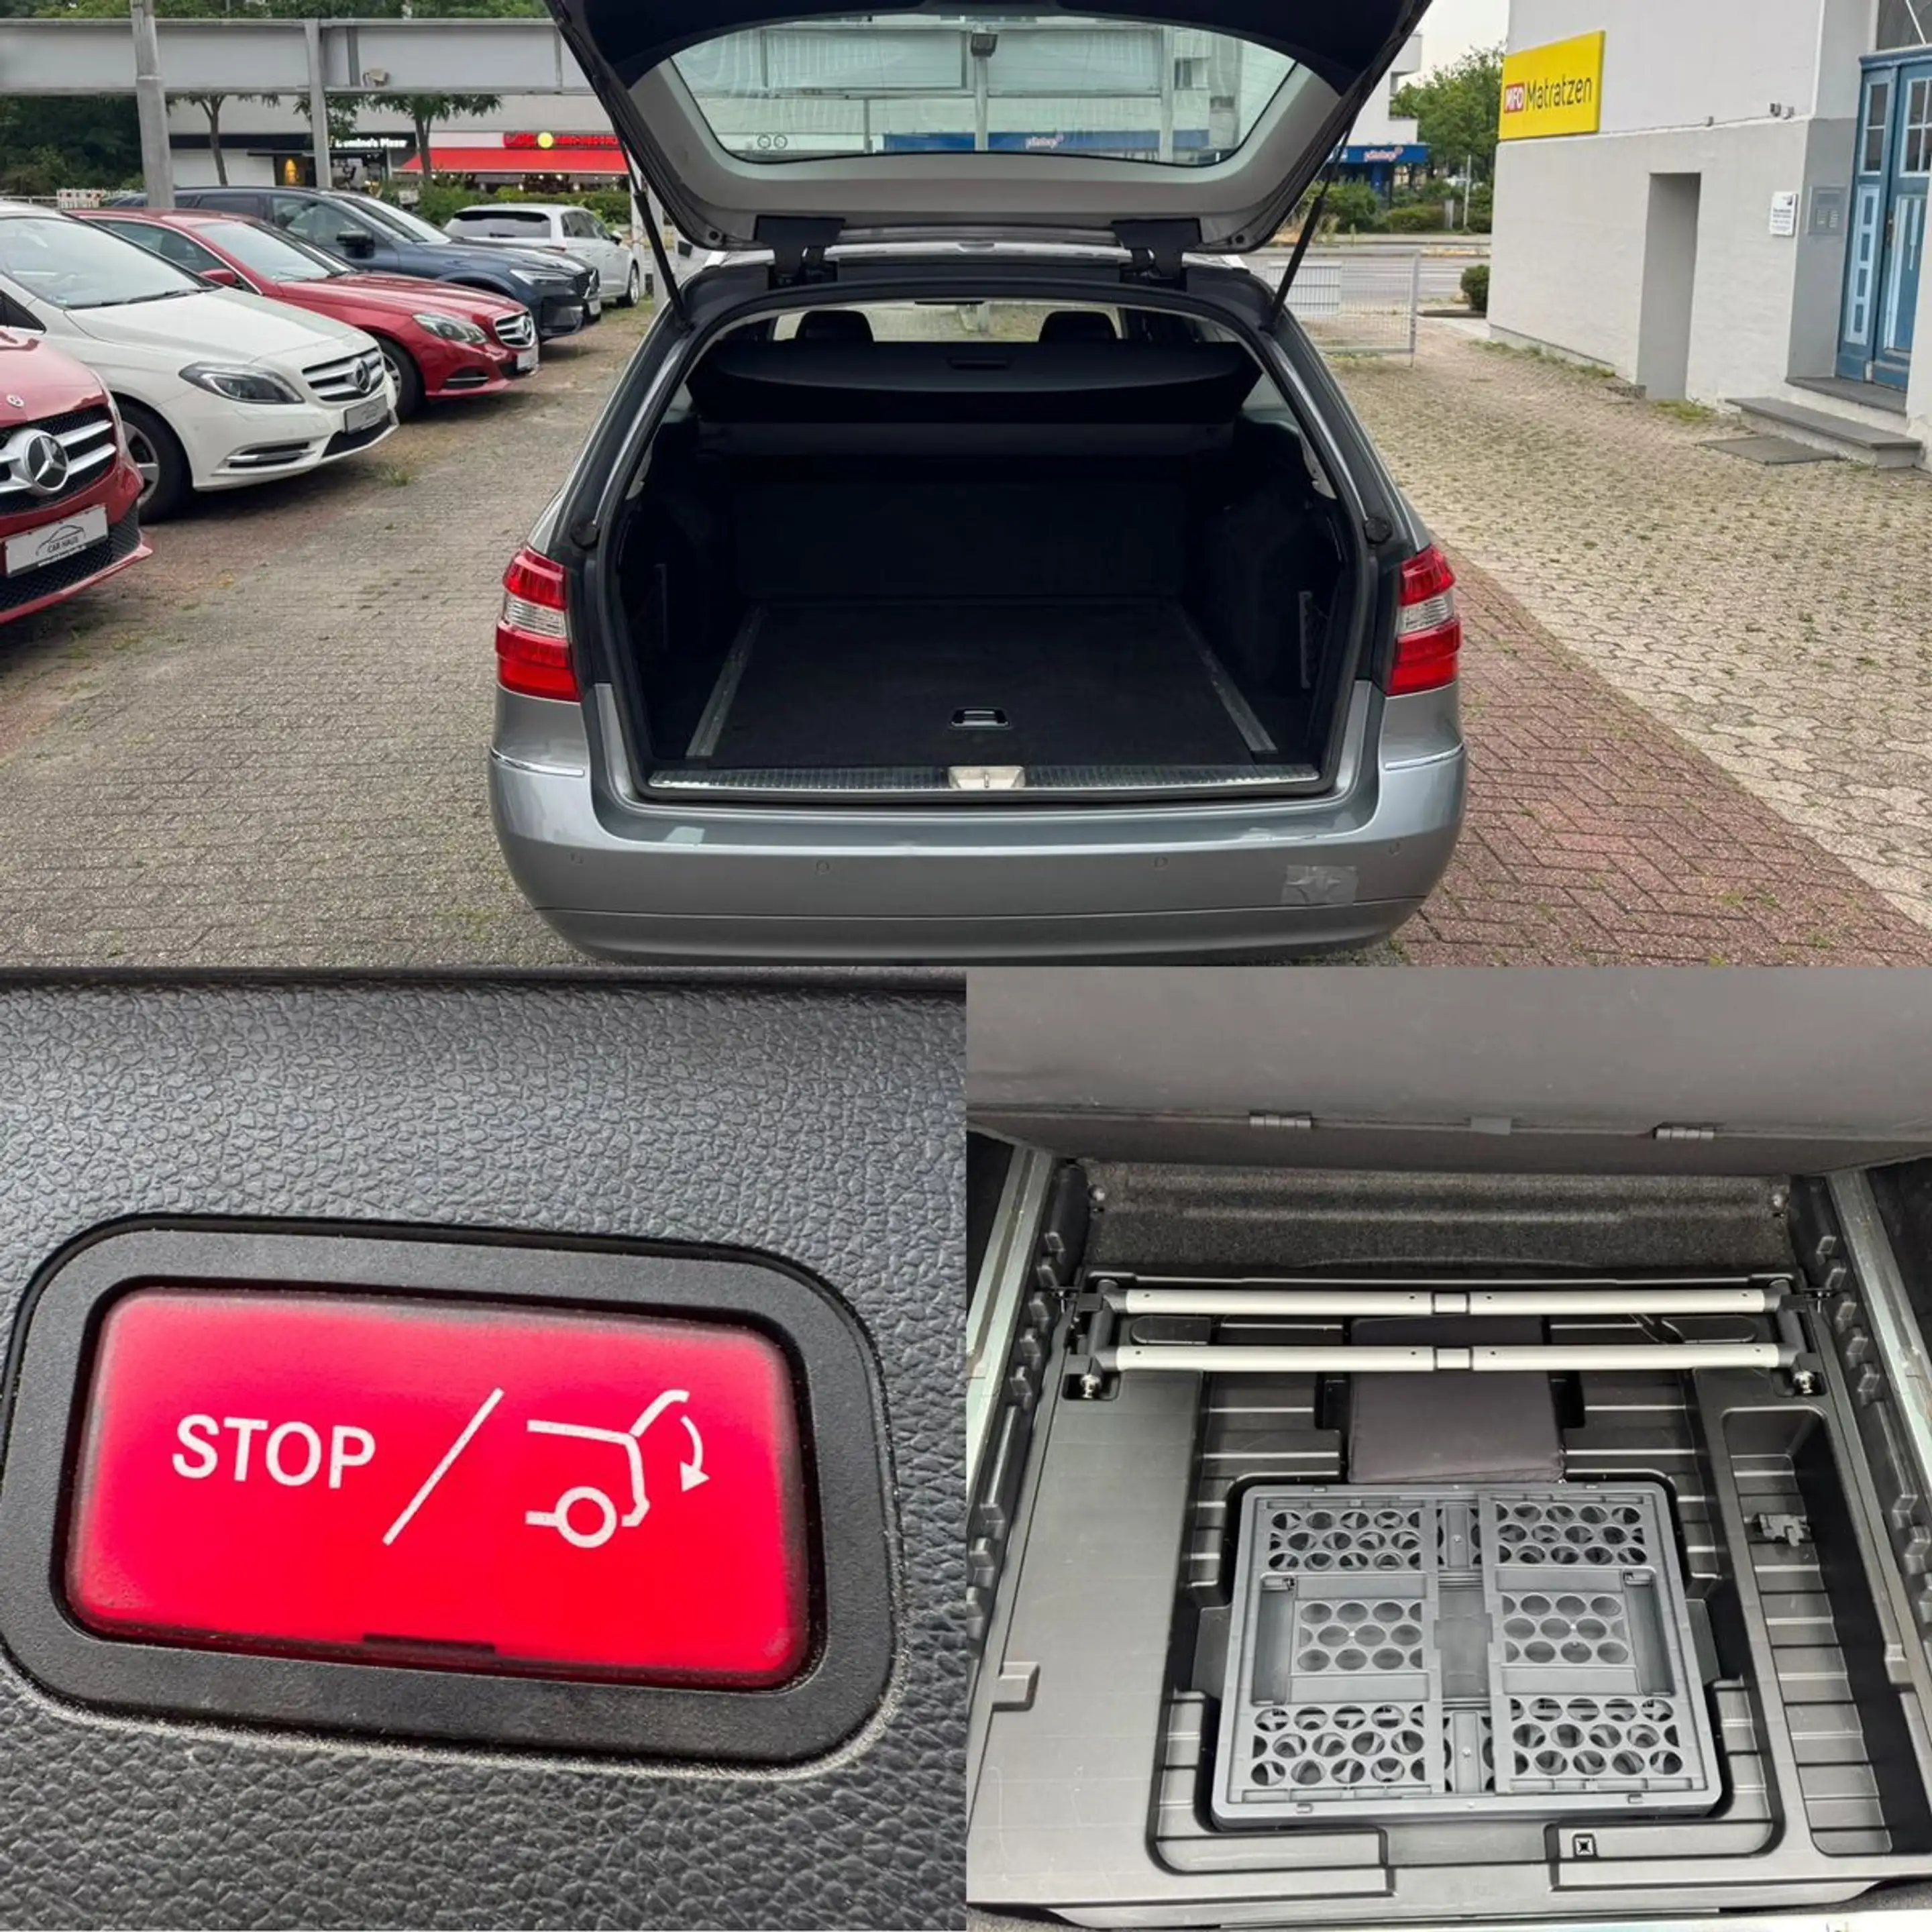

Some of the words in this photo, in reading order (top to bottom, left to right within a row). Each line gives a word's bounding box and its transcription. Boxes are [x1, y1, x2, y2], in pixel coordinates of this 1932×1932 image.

[1526, 74, 1592, 111] Matratzen
[48, 542, 60, 553] CAR
[172, 1414, 376, 1489] STOP
